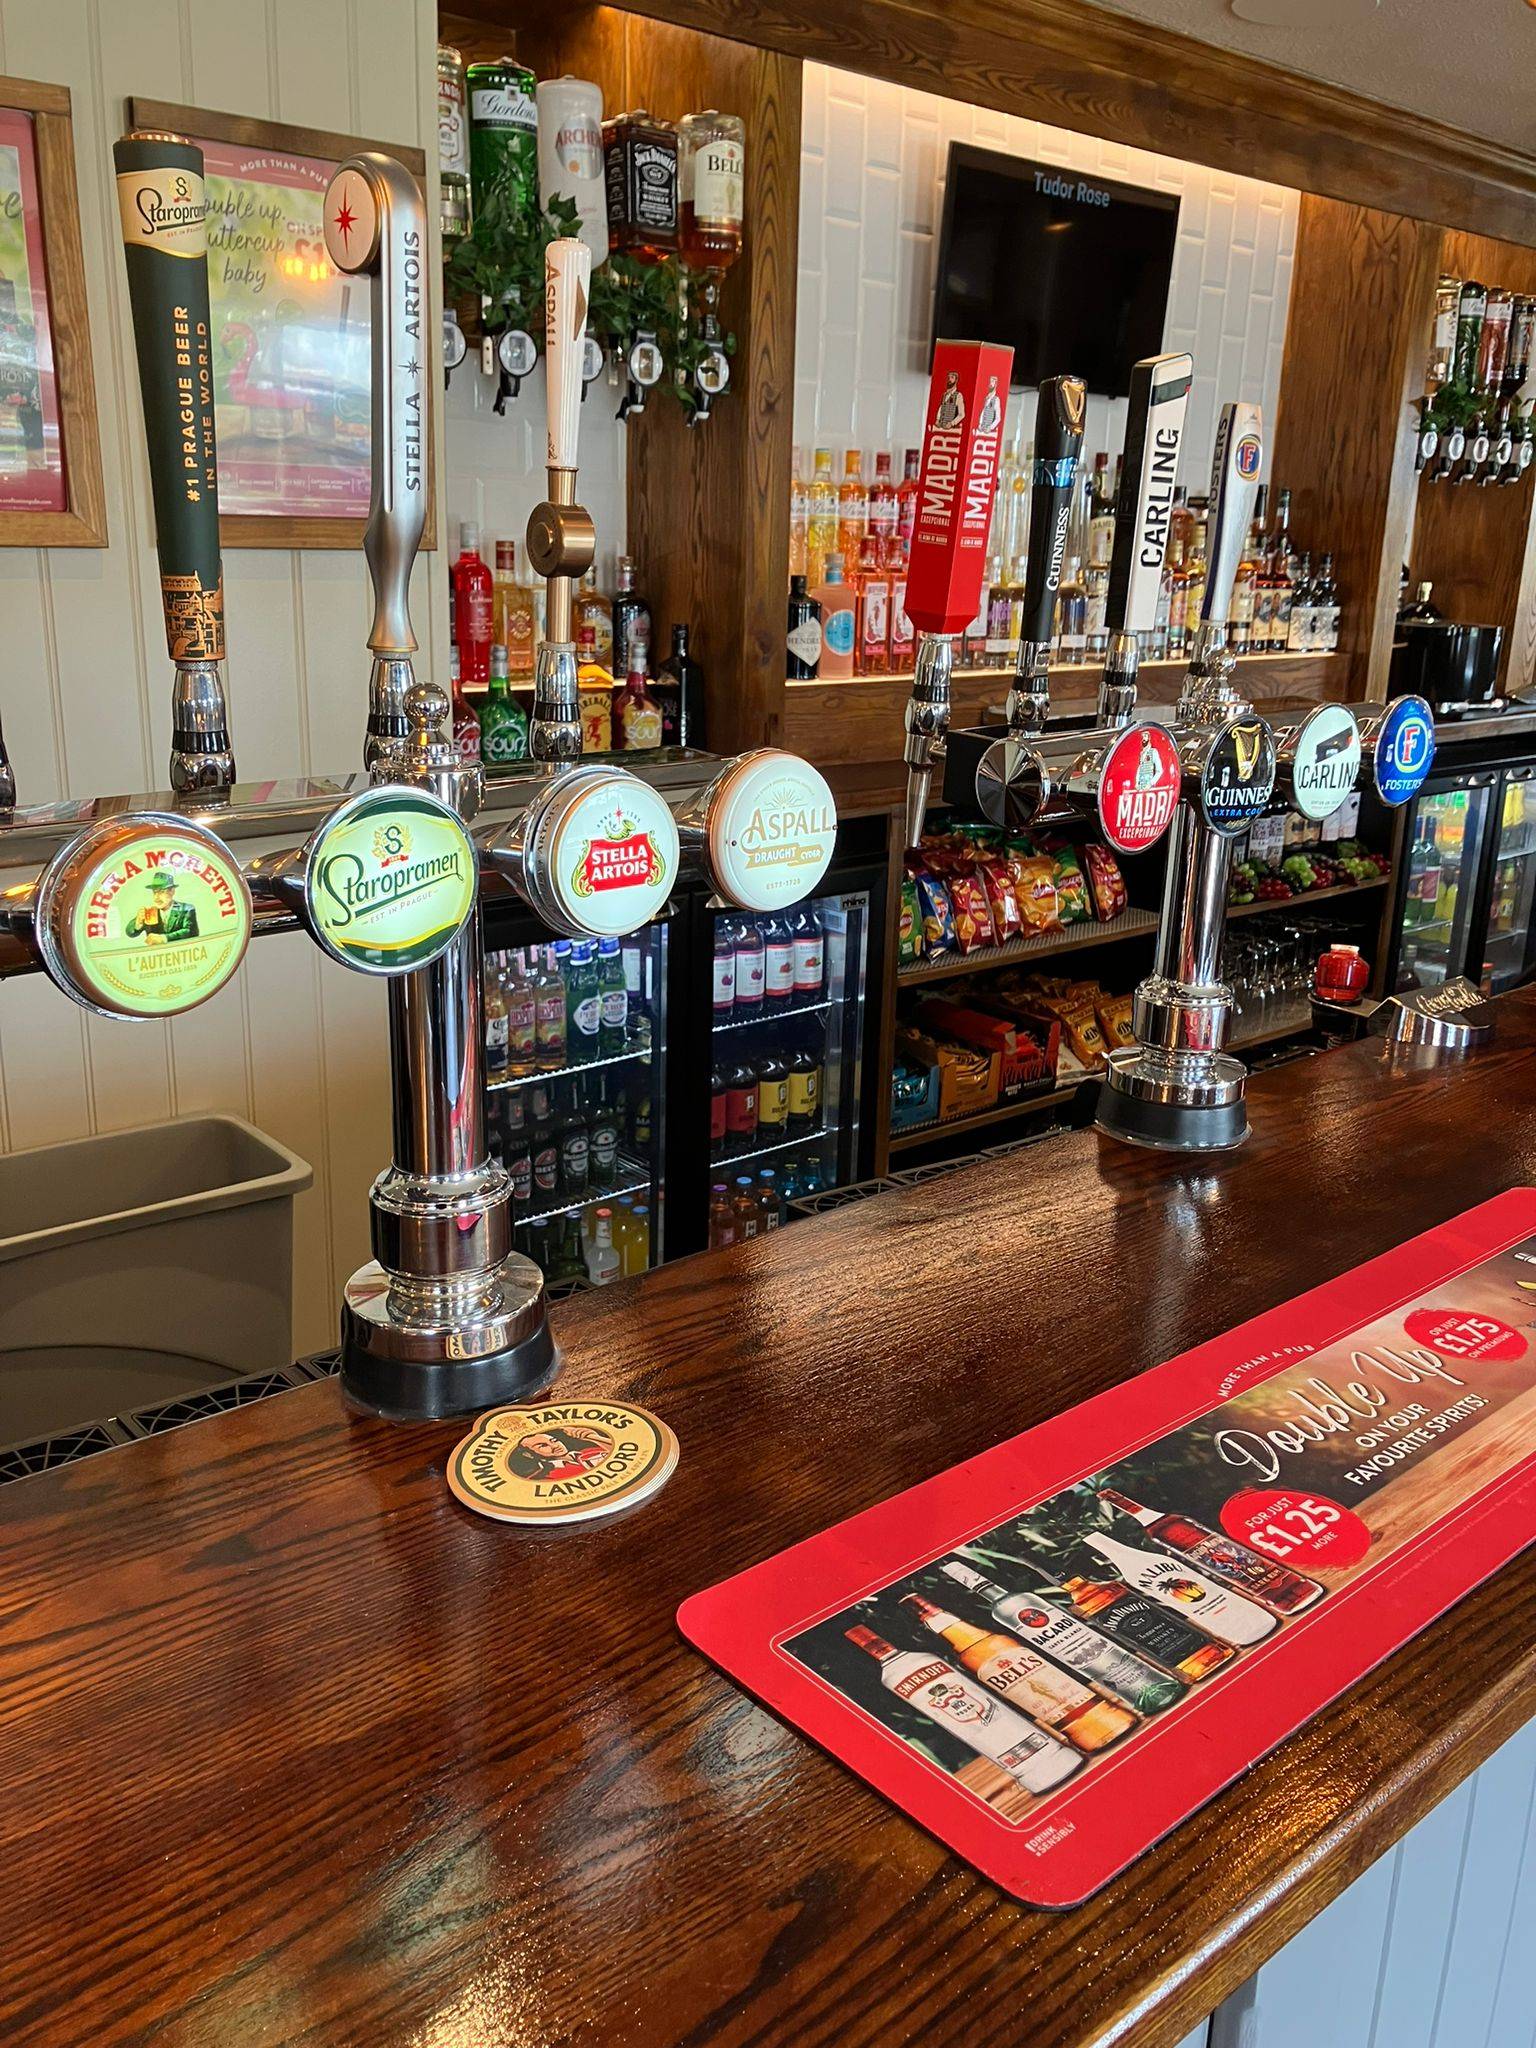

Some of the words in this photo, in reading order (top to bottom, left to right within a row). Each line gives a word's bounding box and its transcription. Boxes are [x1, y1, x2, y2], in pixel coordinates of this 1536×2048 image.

[270, 158, 298, 173] THAN
[203, 189, 257, 220] ouble
[1034, 171, 1075, 199] Tudor
[1077, 181, 1110, 208] Rose
[207, 225, 286, 262] uttercup
[222, 257, 268, 293] baby
[404, 231, 421, 341] ARTOIS
[173, 306, 190, 366] BEER
[197, 322, 211, 405] WORLD
[178, 377, 199, 469] PRAGUE
[202, 416, 213, 458] THE
[405, 391, 421, 492] STELLA
[206, 467, 216, 490] IN
[1140, 428, 1180, 568] CARLING
[1046, 506, 1070, 592] GUINNESS
[741, 805, 832, 855] ASPALL
[1213, 808, 1242, 818] EXTRA
[591, 844, 648, 865] STELLA
[591, 859, 649, 882] ARTOIS
[754, 847, 798, 864] DRAUGHT
[800, 849, 821, 861] CYDER
[87, 859, 143, 939] BIRRA
[145, 849, 237, 918] MORETTI
[323, 851, 464, 927] Staropramen
[400, 892, 432, 909] PRAGUE
[128, 945, 208, 973] L'AUTENTICA
[1433, 1317, 1500, 1354] £1.75
[1440, 1317, 1460, 1331] JUST
[1217, 1371, 1242, 1397] MORE
[1235, 1354, 1270, 1373] THAN
[1283, 1344, 1315, 1355] PUB
[1467, 1347, 1482, 1358] ON
[1214, 1377, 1386, 1482] Double
[1350, 1346, 1465, 1386] Up
[1355, 1424, 1382, 1449] ON
[1379, 1401, 1431, 1432] YOUR
[470, 1430, 510, 1493] TIMOTHY
[526, 1408, 634, 1430] TAYLOR'S
[1344, 1427, 1438, 1486] FAVOURITE
[1428, 1392, 1490, 1434] SPIRITS!
[534, 1442, 639, 1498] LANDLORD
[565, 1488, 600, 1502] CLASSIC
[1244, 1511, 1271, 1529] FOR
[1267, 1497, 1294, 1516] JUST
[1249, 1498, 1341, 1557] £1.25
[1311, 1531, 1339, 1550] MORE
[1138, 1562, 1183, 1591] MALIBU
[899, 1662, 946, 1696] SMIRNOFF
[987, 1655, 1044, 1691] BELL'S
[1028, 1825, 1057, 1848] DRINK
[1037, 1821, 1077, 1854] SENSIBLY
